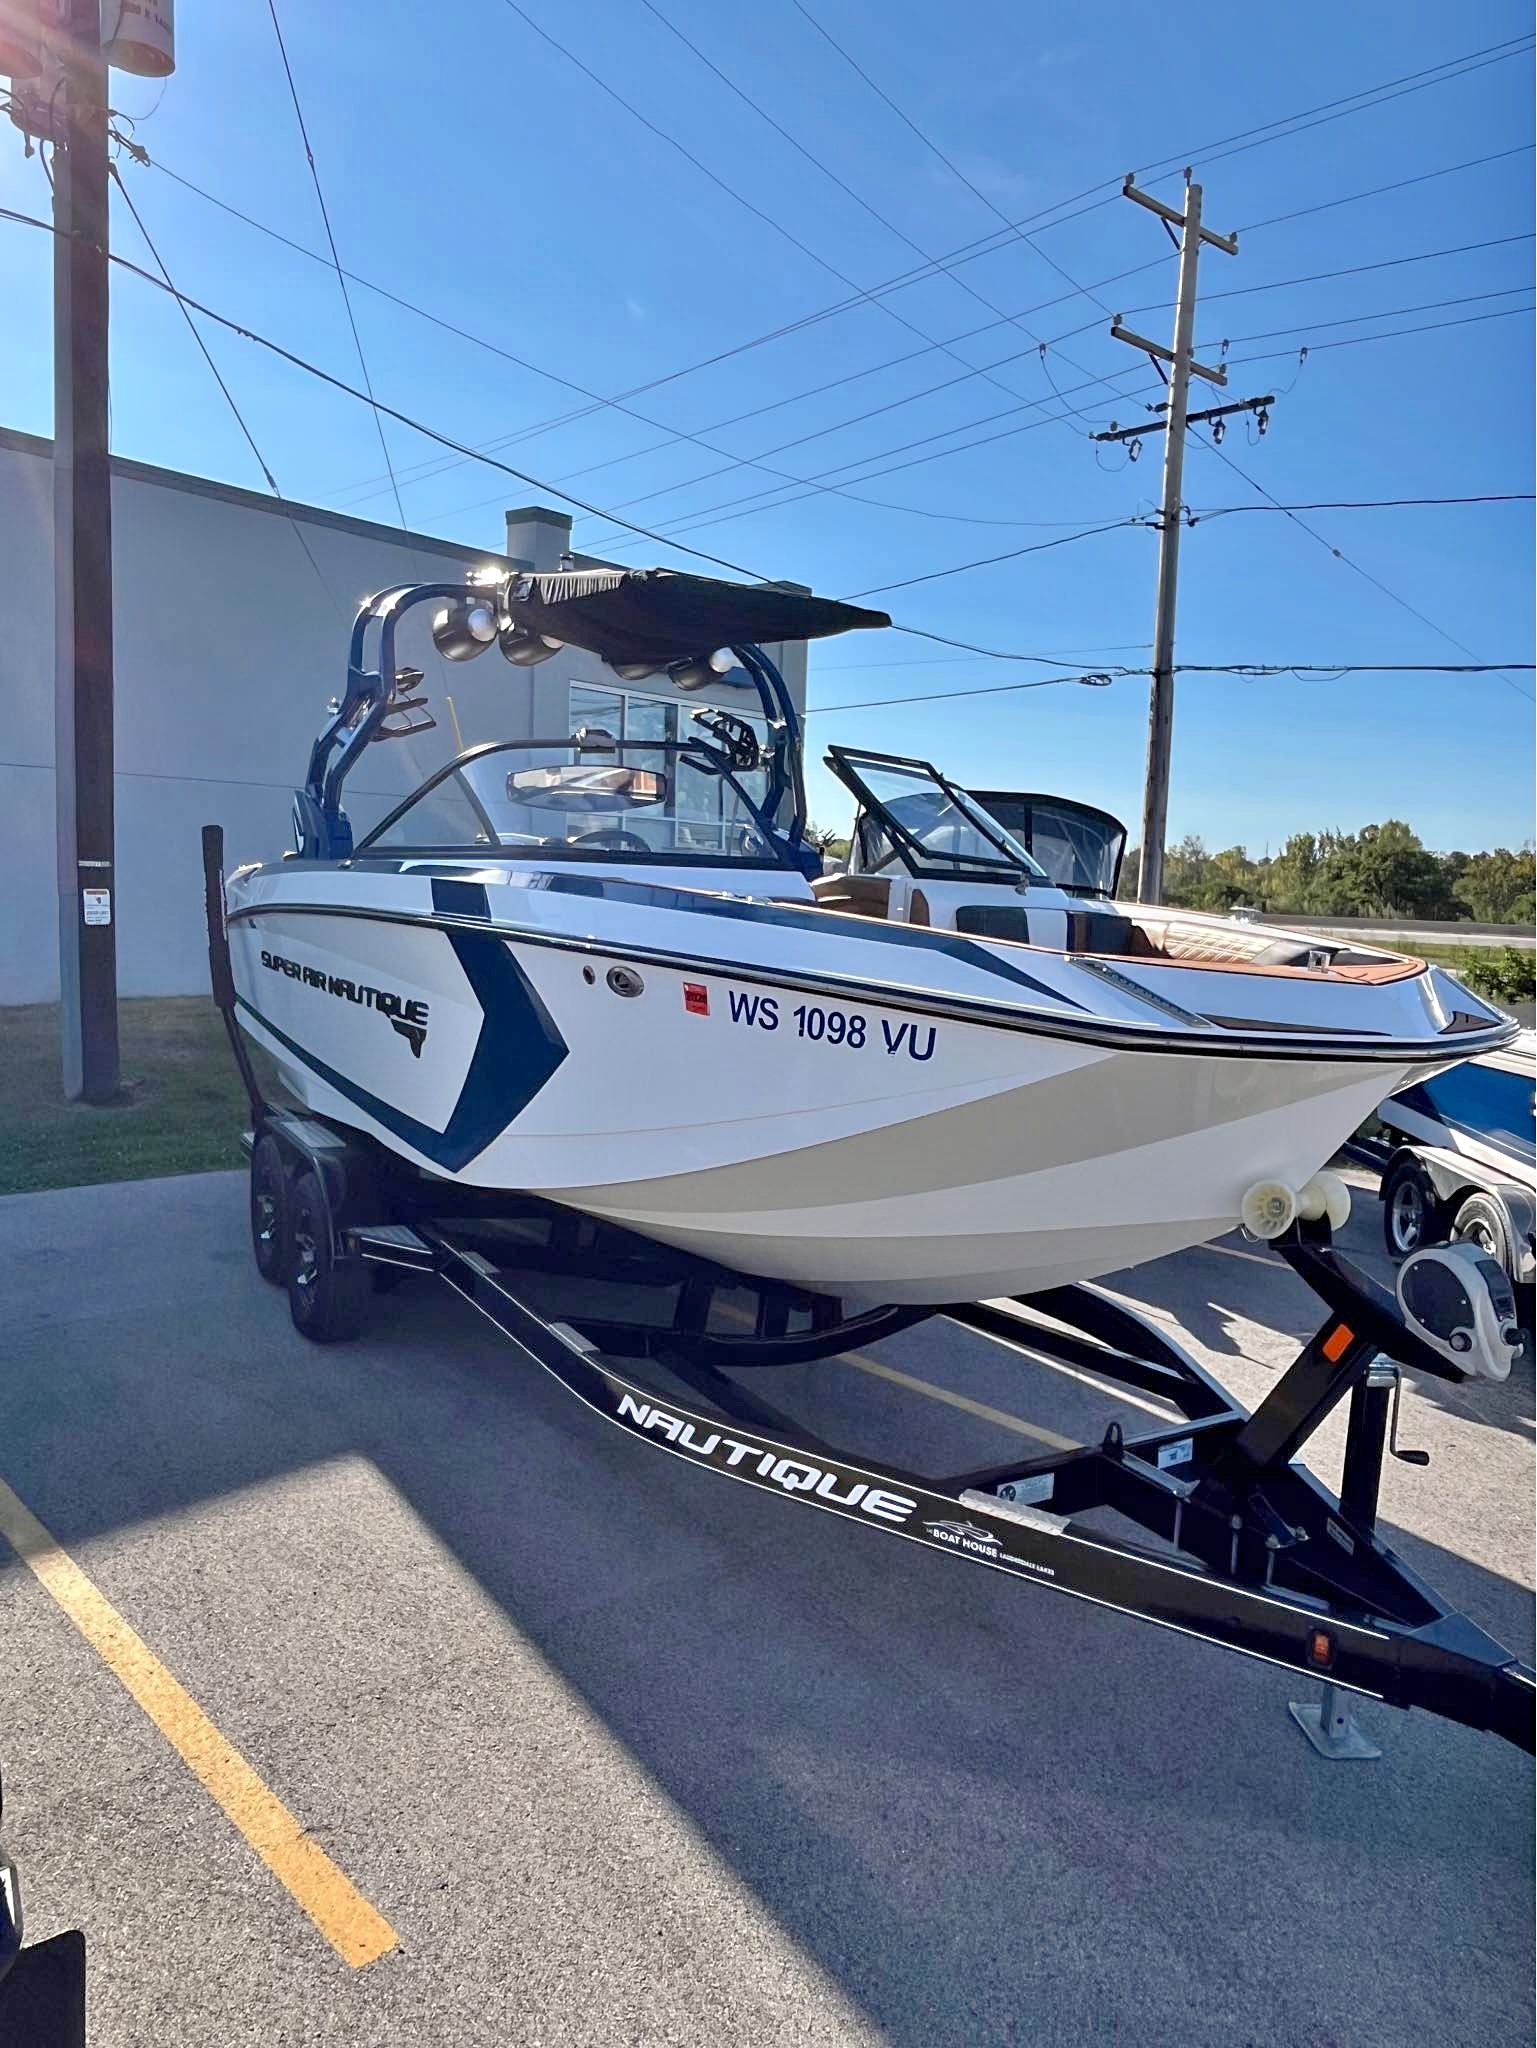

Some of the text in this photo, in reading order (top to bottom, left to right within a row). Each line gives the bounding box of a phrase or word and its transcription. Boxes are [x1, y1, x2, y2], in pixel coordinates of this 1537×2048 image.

[261, 950, 430, 1026] SUPER AIR NAUTIQUE
[728, 990, 937, 1061] WS 1098 VU
[617, 1394, 918, 1522] NAUTIQUE
[933, 1528, 961, 1545] BOAT
[962, 1537, 998, 1558] HOUSE
